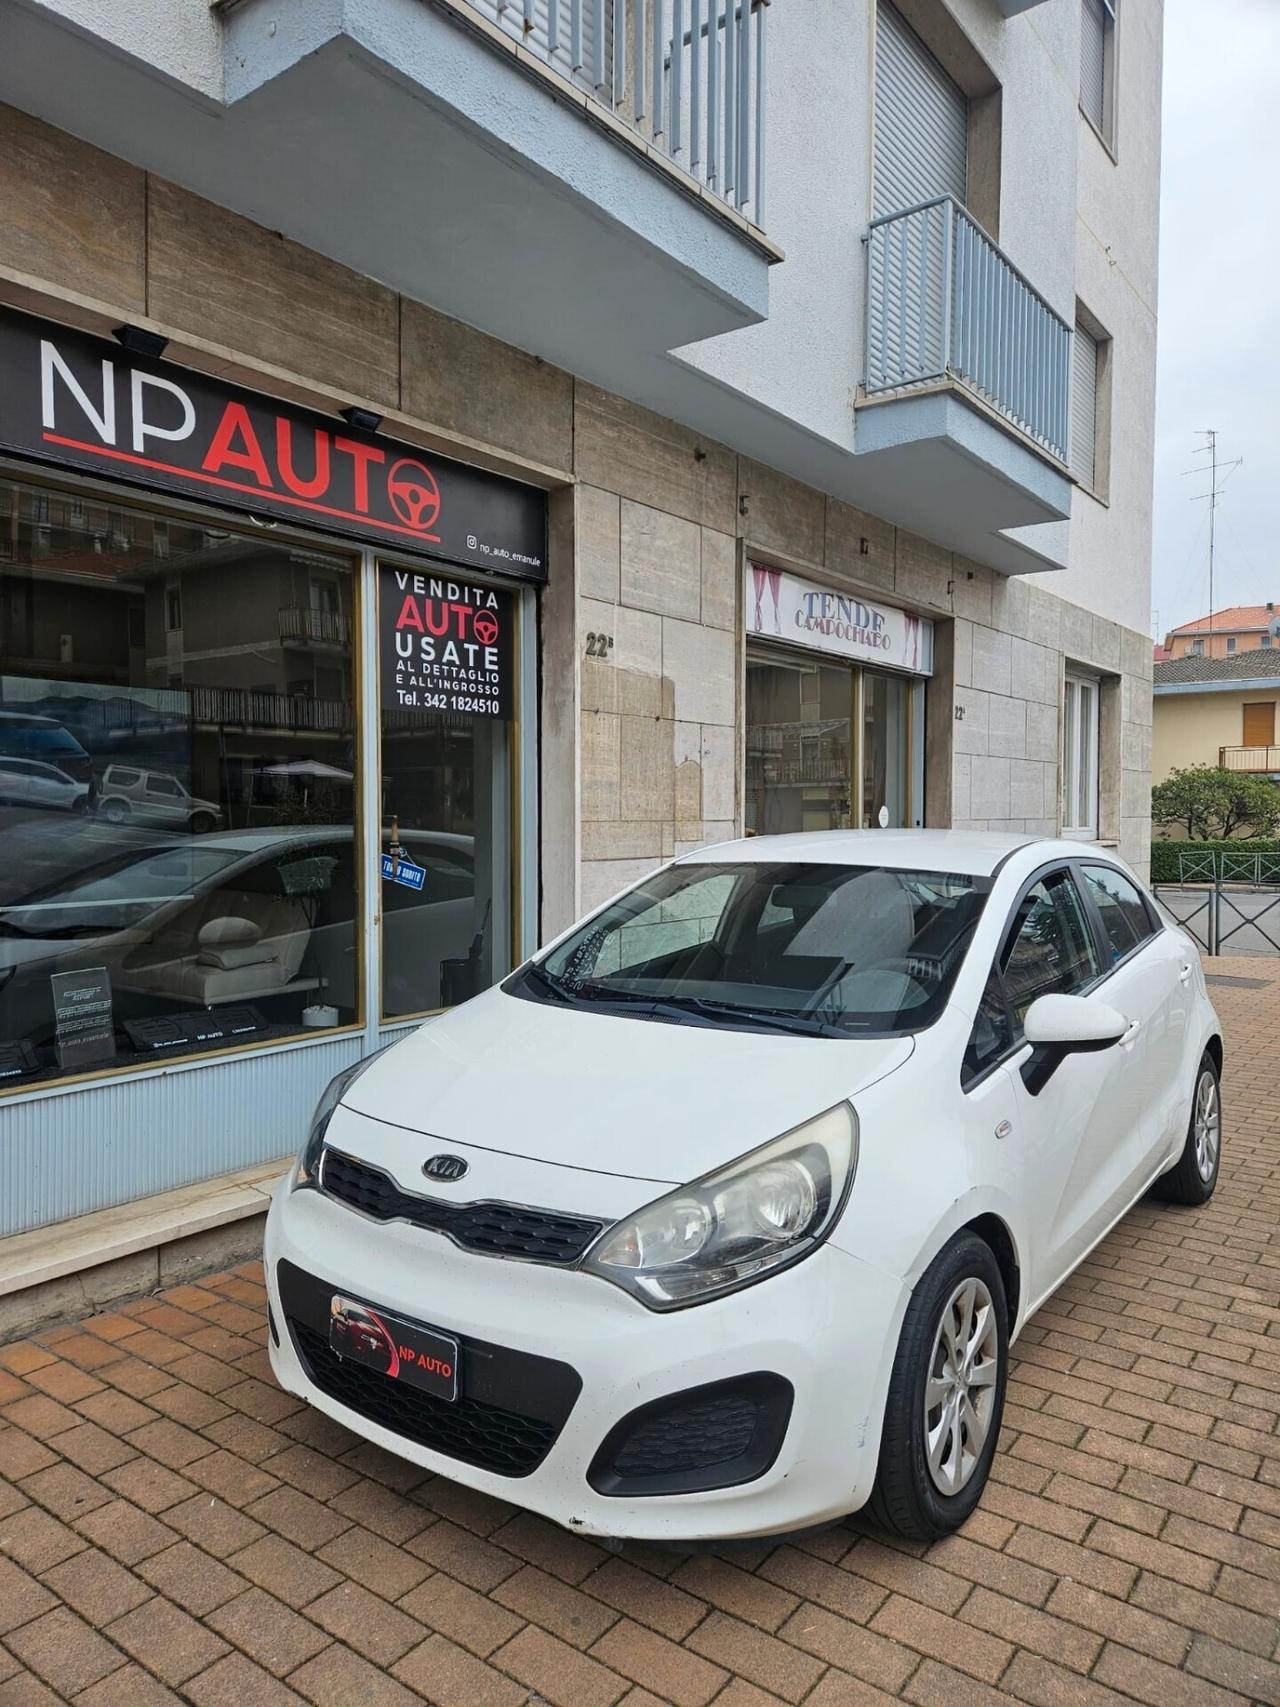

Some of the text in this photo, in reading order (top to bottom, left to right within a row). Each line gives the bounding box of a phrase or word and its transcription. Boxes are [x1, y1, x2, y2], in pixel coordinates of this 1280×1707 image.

[395, 571, 499, 610] VENDITA
[395, 632, 499, 671] USATE
[396, 660, 499, 683] AL DETTAGLIO
[396, 674, 499, 695] E ALL'INGROSSO
[397, 690, 499, 714] Tel. 342 1824510
[427, 1158, 461, 1177] KIA
[398, 1346, 452, 1378] NP AUTO
